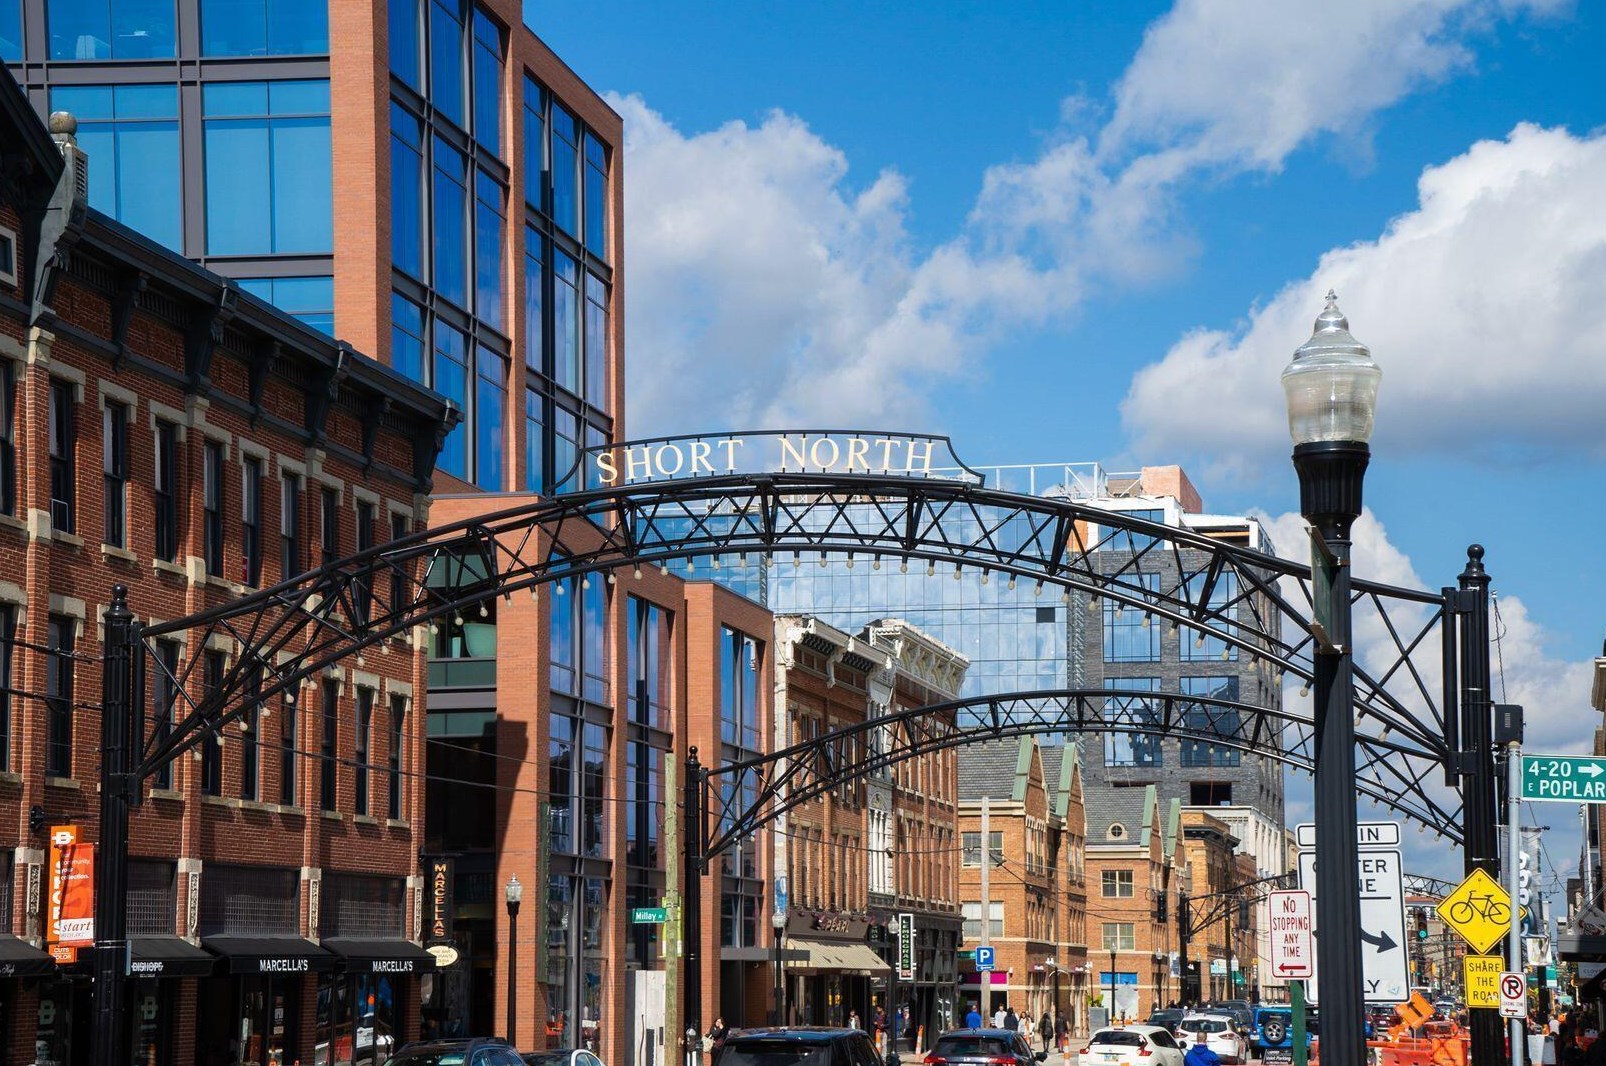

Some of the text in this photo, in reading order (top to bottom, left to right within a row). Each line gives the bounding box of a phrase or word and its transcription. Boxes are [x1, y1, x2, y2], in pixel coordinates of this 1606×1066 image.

[596, 438, 935, 483] SHORT NORTH
[1528, 760, 1572, 777] 4-20
[1528, 780, 1606, 798] E POPLAR
[433, 863, 447, 937] MARCELLAS
[1283, 900, 1296, 913] NO
[635, 911, 657, 921] Millay
[62, 921, 92, 933] start
[825, 920, 849, 933] PEARL
[1272, 916, 1308, 931] STOPPING
[902, 919, 910, 969] LEMONGRASS
[1284, 933, 1299, 943] ANY
[1282, 946, 1301, 958] TIME
[259, 959, 309, 972] MARCELLA'S
[372, 960, 413, 972] MARCELLA'S
[1468, 962, 1501, 973] SHARE
[1476, 976, 1495, 987] THE
